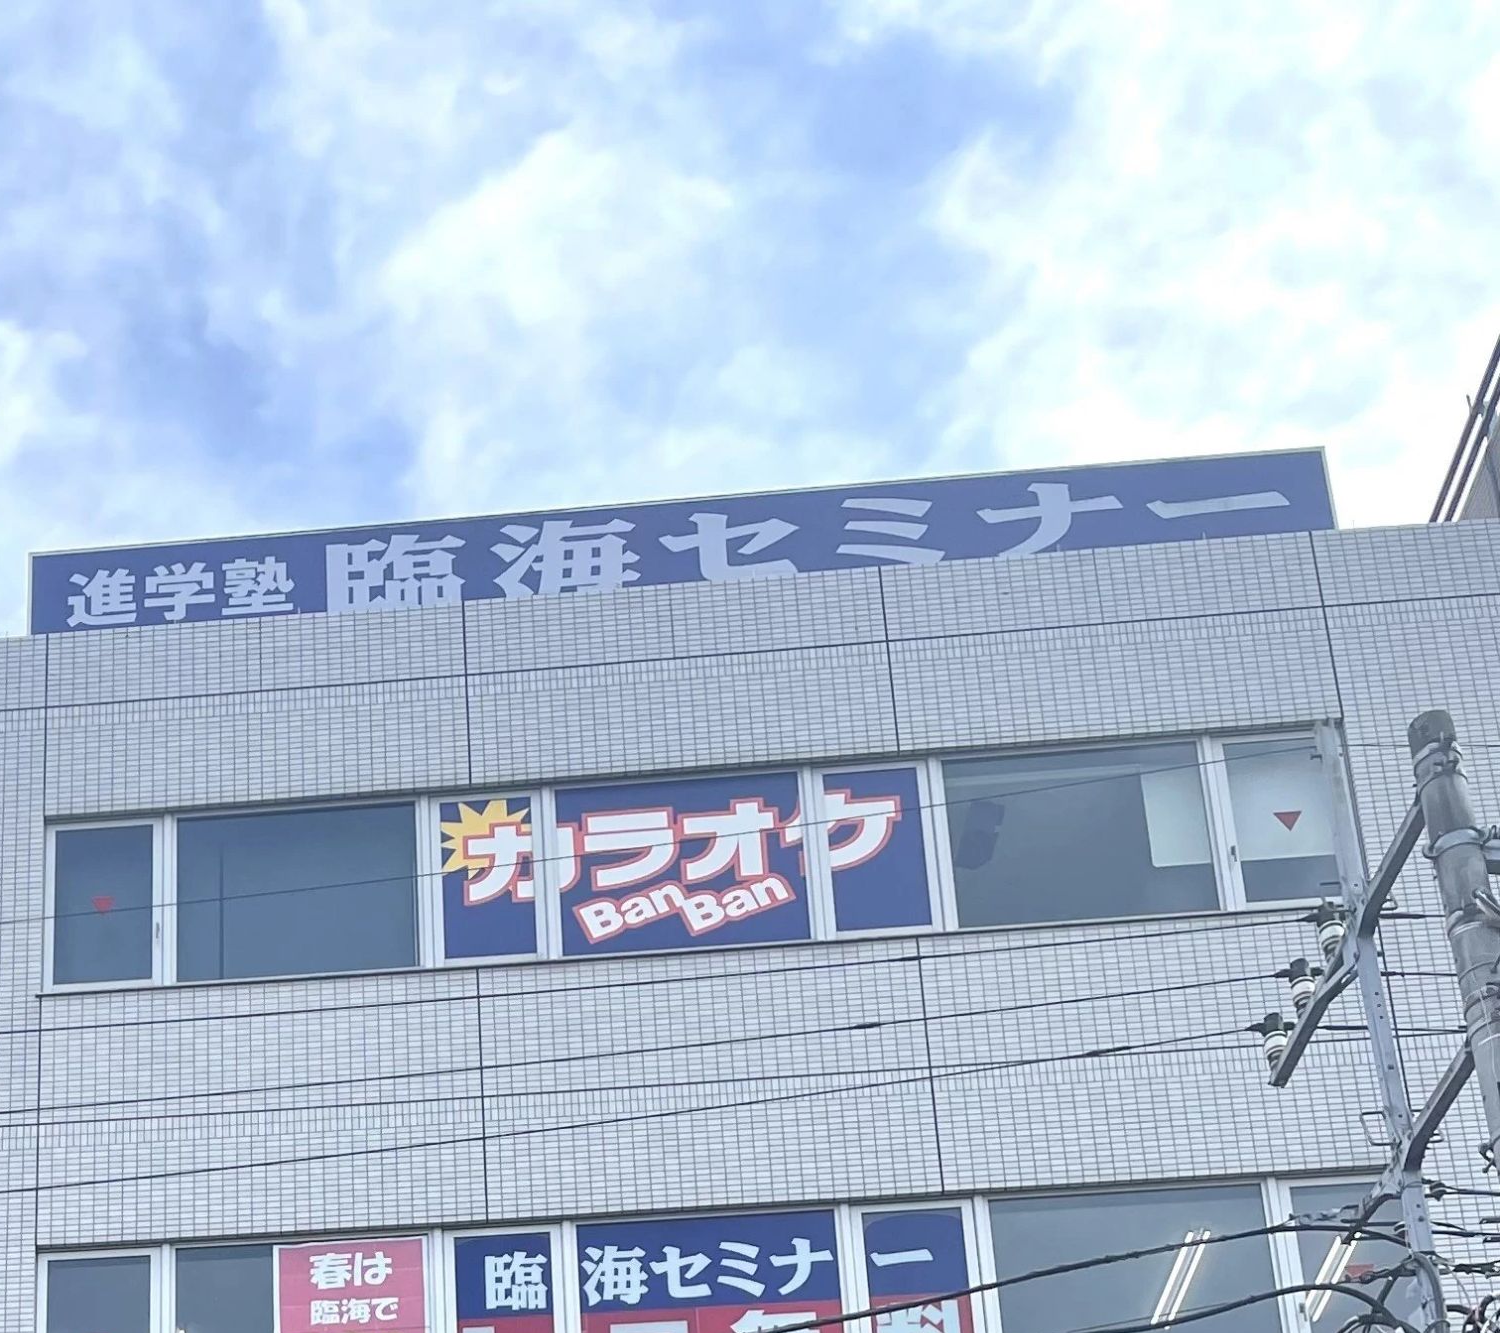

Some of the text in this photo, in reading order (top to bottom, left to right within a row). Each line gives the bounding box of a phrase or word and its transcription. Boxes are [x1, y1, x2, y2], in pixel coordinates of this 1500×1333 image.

[67, 481, 1290, 627] 進学塾 臨海セミナー
[464, 789, 901, 906] カラオケ
[573, 874, 796, 944] BanBan
[309, 1251, 393, 1289] 春は
[484, 1237, 935, 1310] 臨海セミナー
[310, 1297, 399, 1325] 臨海で
